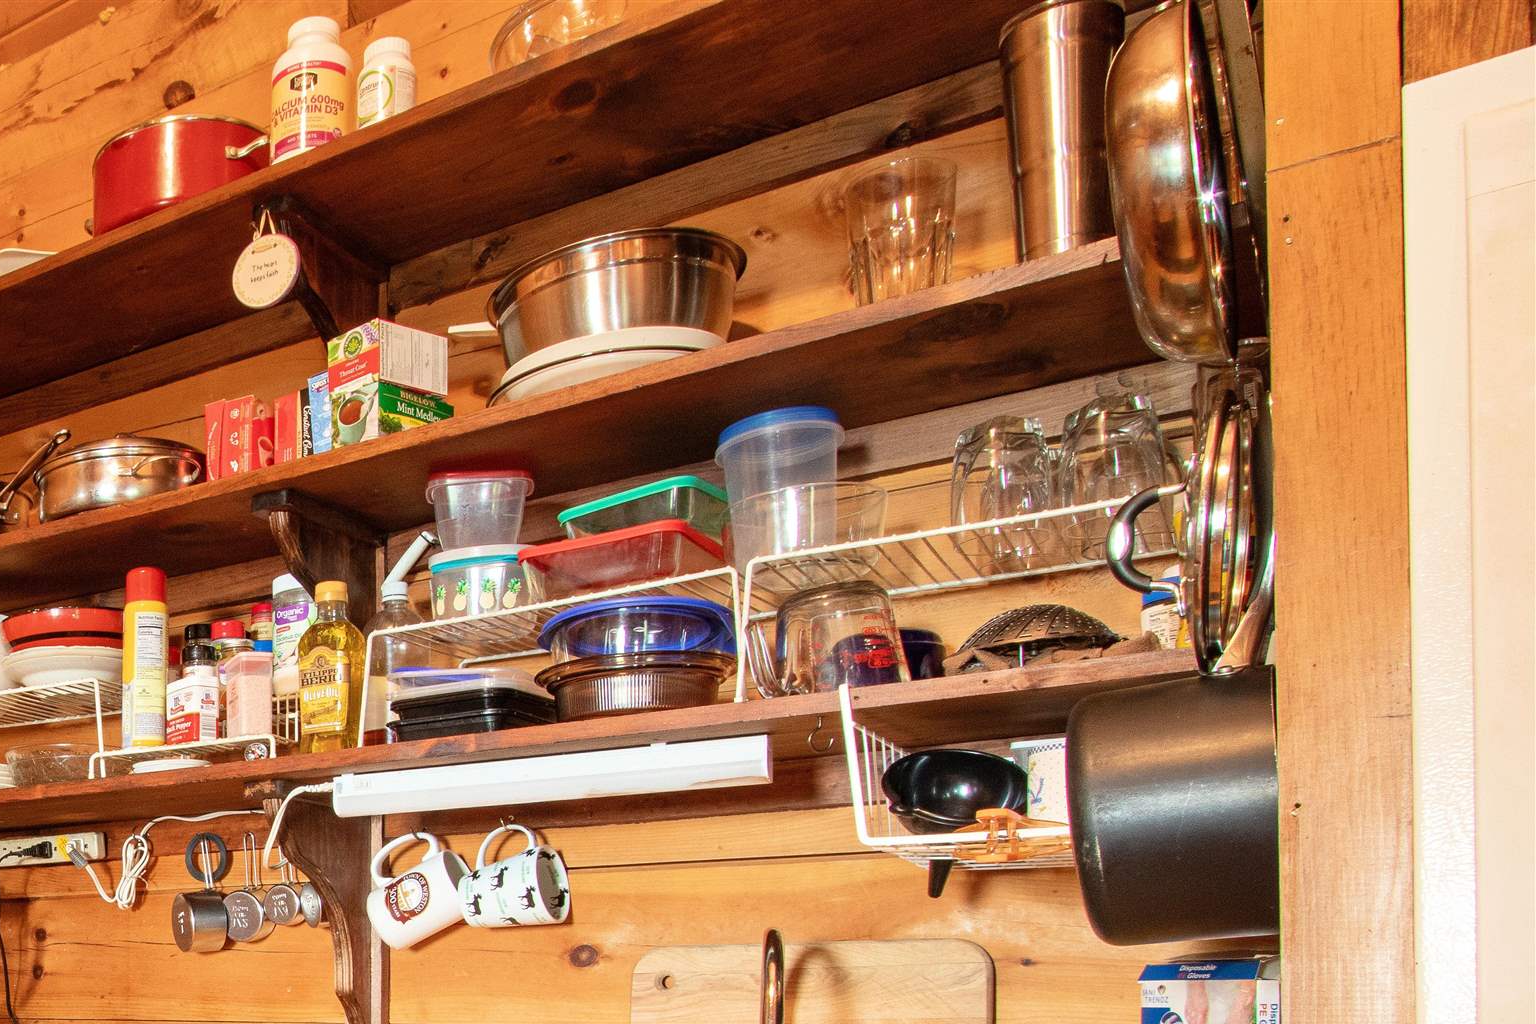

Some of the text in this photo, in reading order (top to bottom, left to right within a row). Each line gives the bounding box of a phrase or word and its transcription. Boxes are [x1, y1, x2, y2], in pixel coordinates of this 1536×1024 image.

[324, 104, 338, 116] D3
[396, 401, 442, 423] Mint Medley
[302, 440, 313, 458] Com
[276, 606, 304, 618] Organic
[414, 885, 429, 914] WESTON
[1179, 964, 1217, 972] Disposable
[1259, 1003, 1268, 1017] PE
